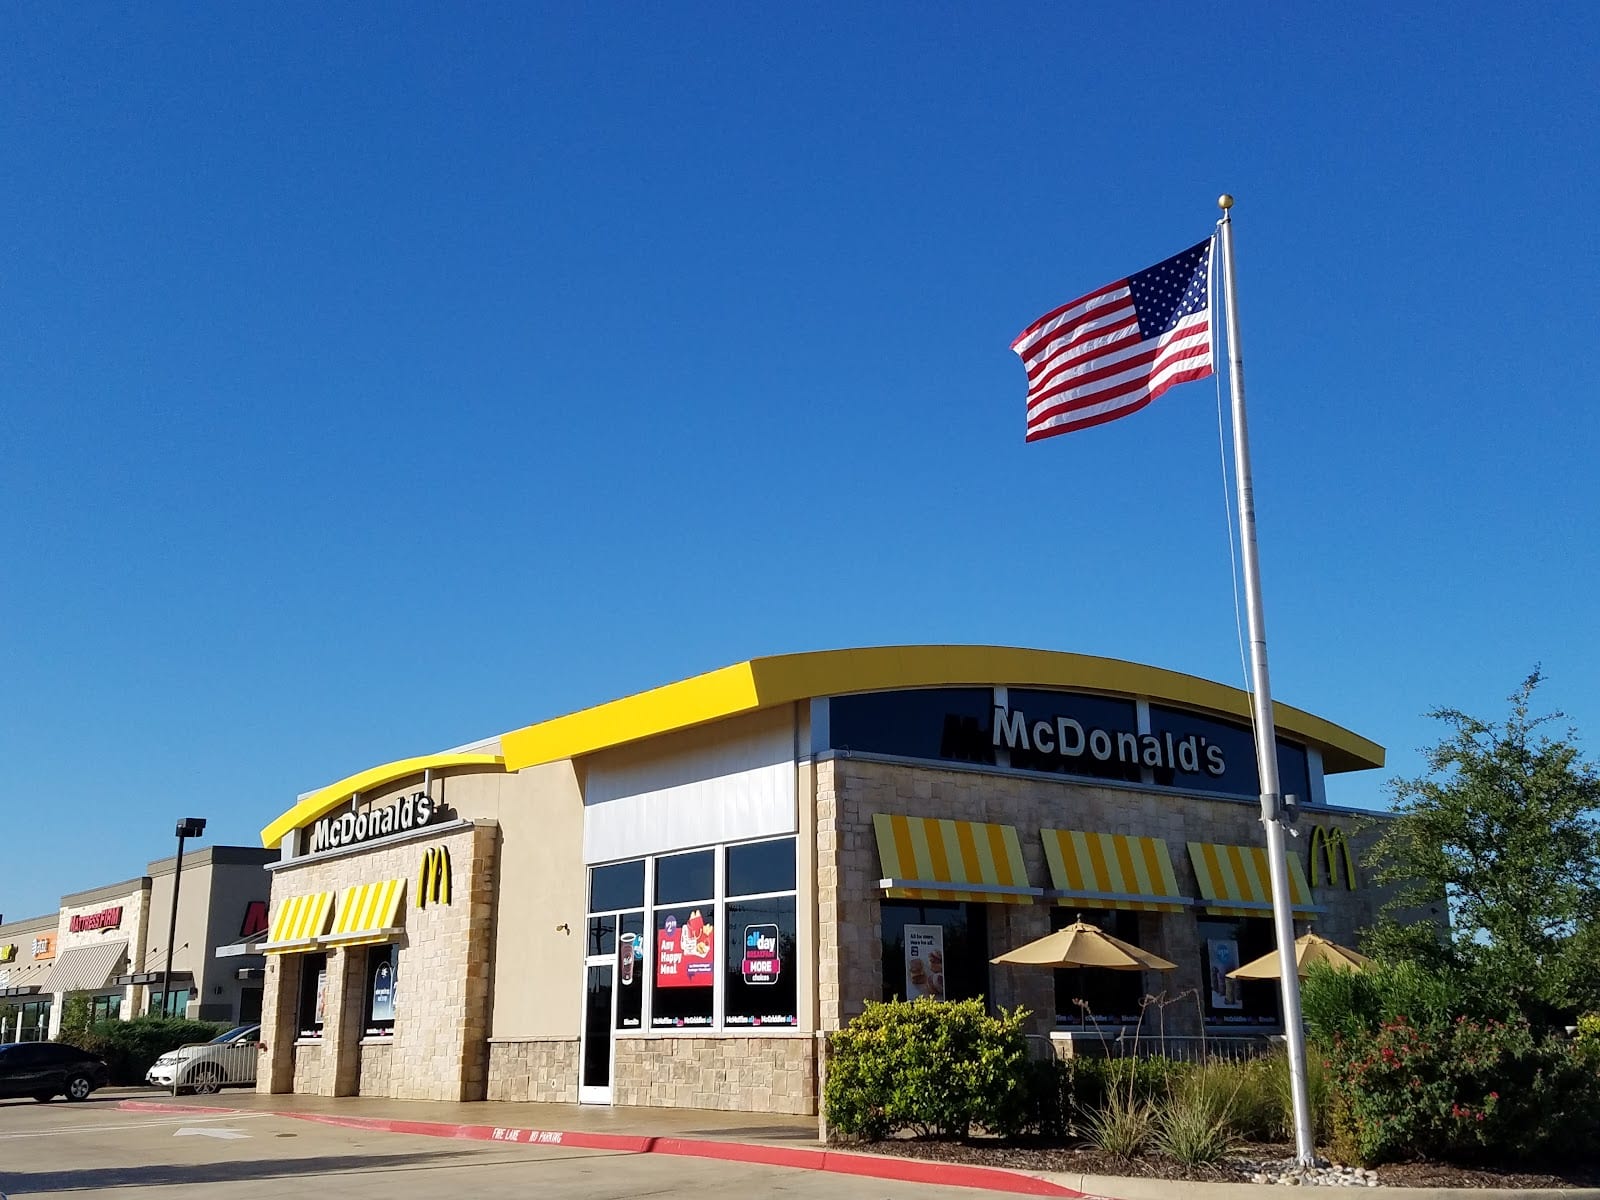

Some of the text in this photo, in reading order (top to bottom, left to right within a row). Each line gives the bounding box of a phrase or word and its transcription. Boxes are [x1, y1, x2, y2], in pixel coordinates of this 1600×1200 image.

[992, 707, 1226, 775] McDonald's
[313, 792, 431, 849] McDonald's
[661, 940, 674, 952] Any
[747, 931, 776, 953] all day
[660, 952, 682, 964] Happy
[750, 961, 772, 973] MORE
[492, 1128, 562, 1143] FIRE LANE NO PARKING
